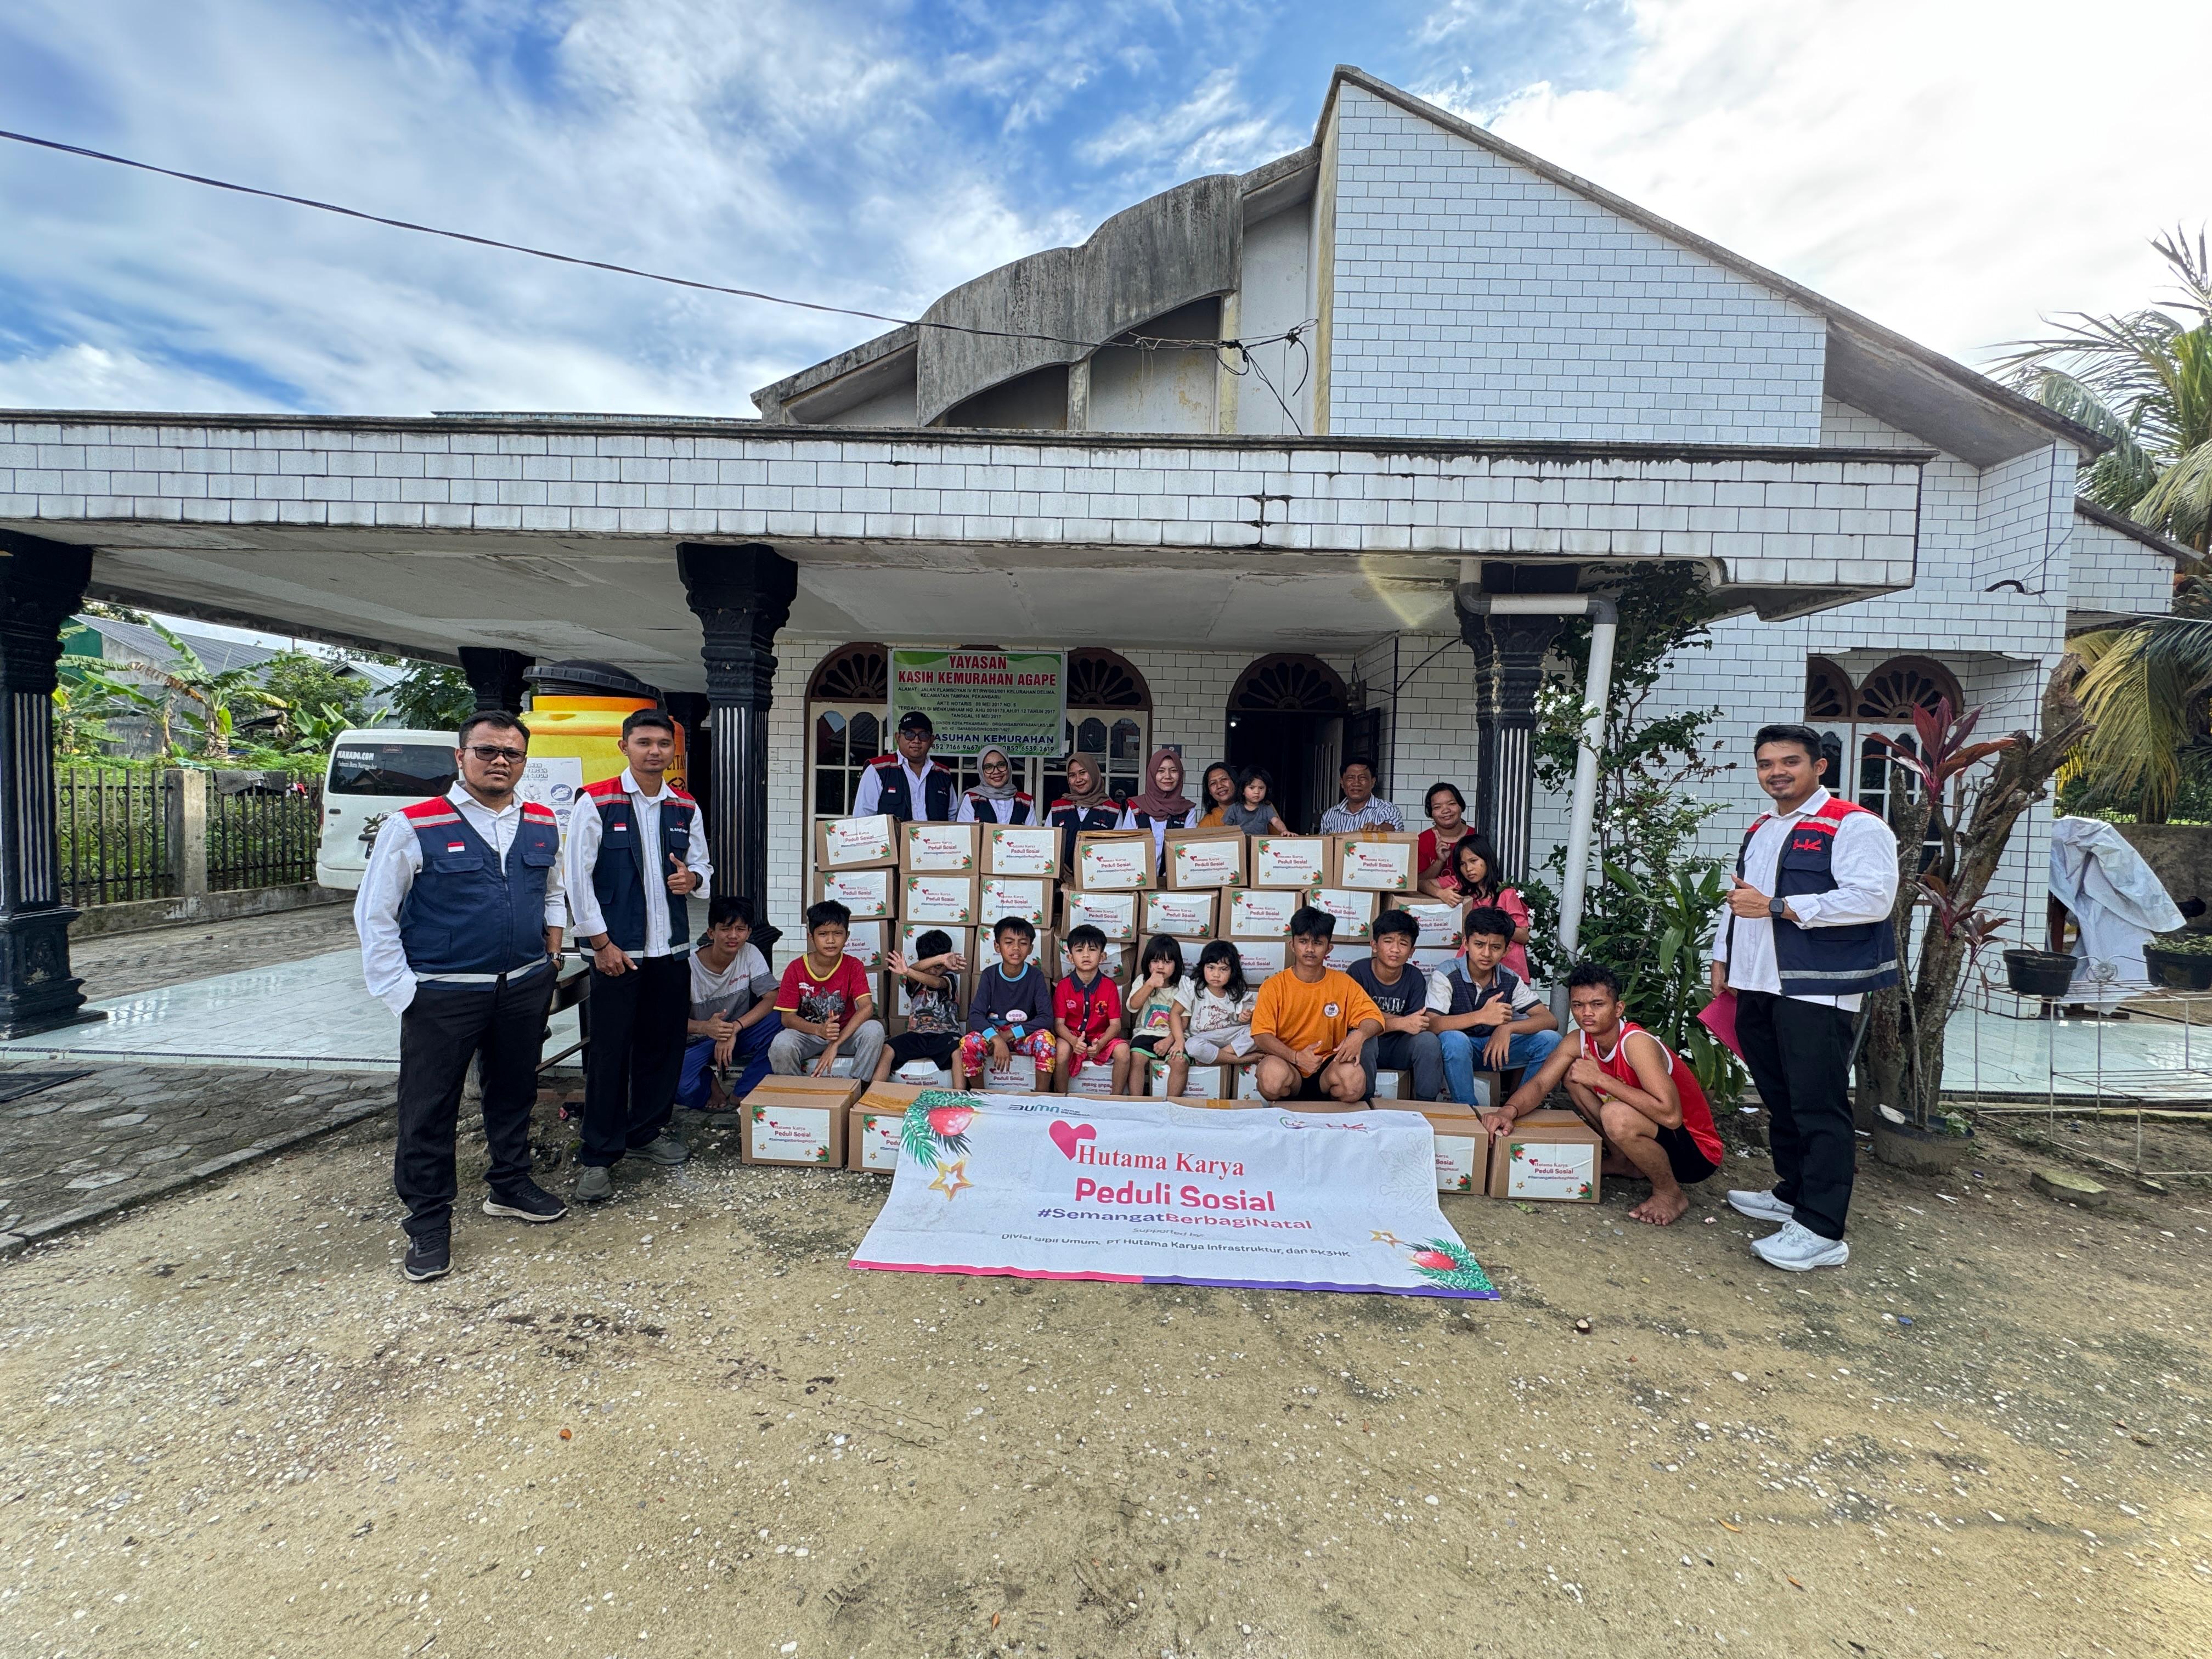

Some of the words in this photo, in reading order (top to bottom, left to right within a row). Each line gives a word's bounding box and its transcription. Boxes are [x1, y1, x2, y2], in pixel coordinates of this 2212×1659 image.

[949, 655, 1007, 669] YAYASAN
[898, 670, 934, 683] KASIH
[938, 672, 1013, 685] KEMURAHAN
[1017, 674, 1057, 686] AGAPE
[934, 733, 980, 742] ASUHAN
[984, 735, 1054, 744] KEMURAHAN
[1076, 1144, 1167, 1170] Hutama
[1175, 1152, 1244, 1180] Karya
[1075, 1177, 1171, 1205] Peduli
[1180, 1185, 1276, 1212] Sosial
[1037, 1208, 1312, 1229] #SemangatBerbagiNatal
[1133, 1227, 1187, 1235] Supported
[1123, 1239, 1168, 1248] Hutama
[1171, 1241, 1204, 1251] Karya
[1207, 1244, 1284, 1255] Infrastruktur,
